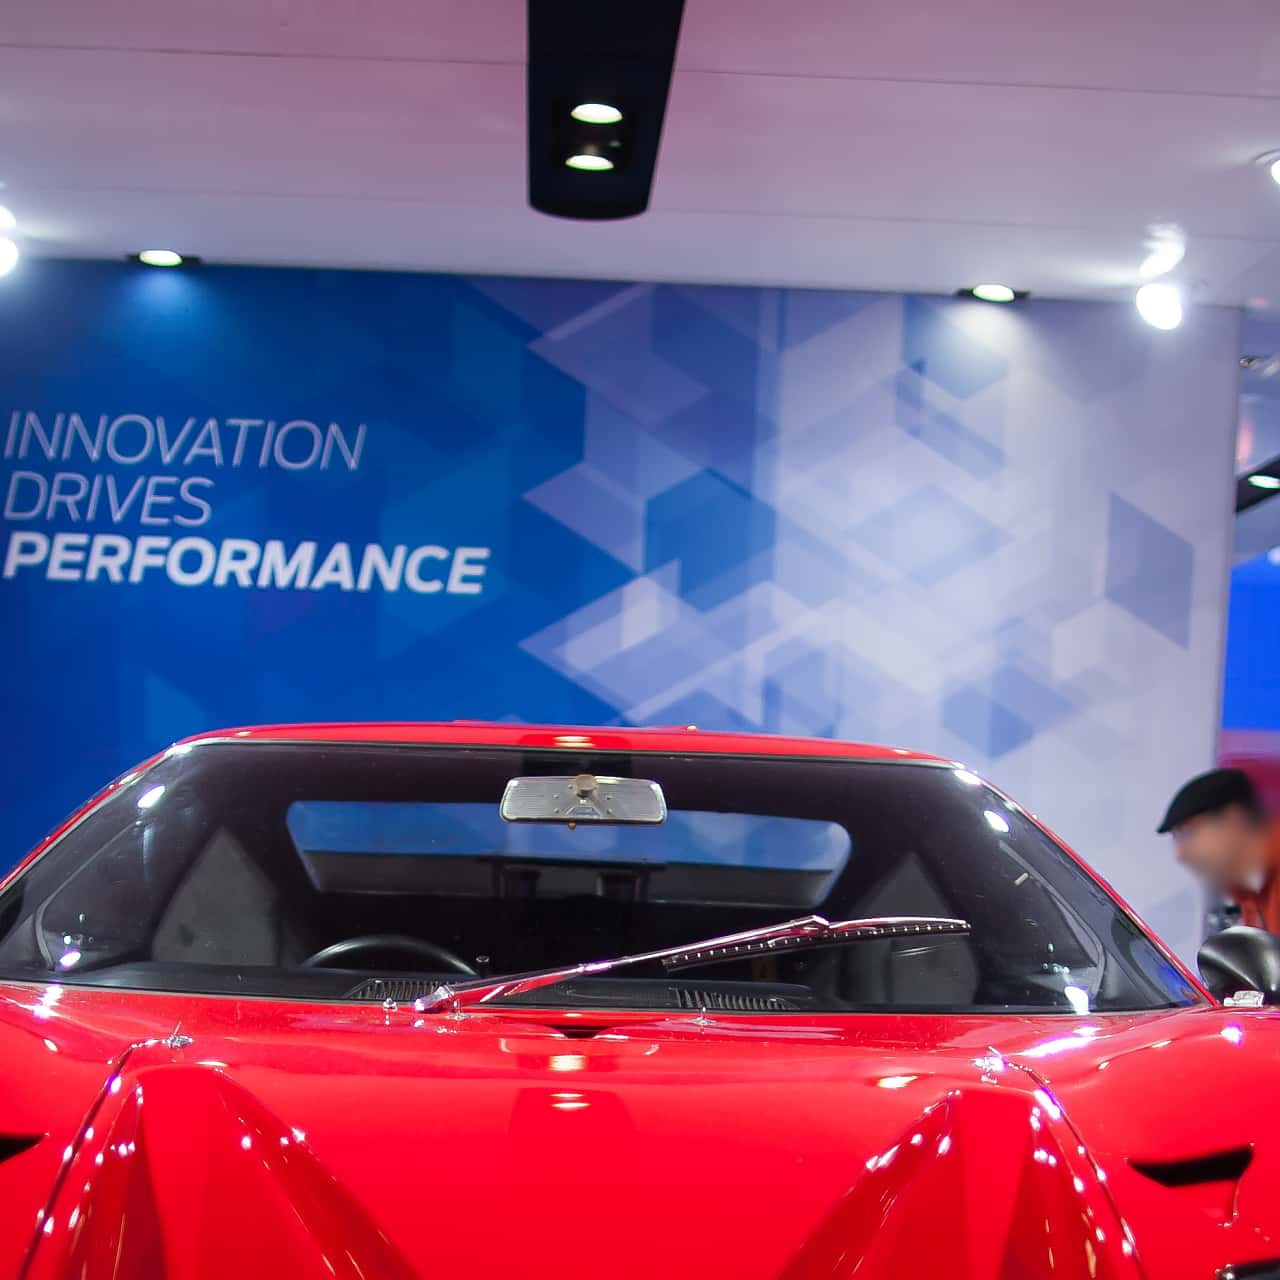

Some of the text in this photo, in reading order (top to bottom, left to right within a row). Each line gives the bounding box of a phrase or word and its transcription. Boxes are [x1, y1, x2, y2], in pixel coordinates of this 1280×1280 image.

[3, 410, 366, 471] INNOVATION
[3, 470, 215, 527] DRIVES
[2, 531, 491, 595] PERFORMANCE
